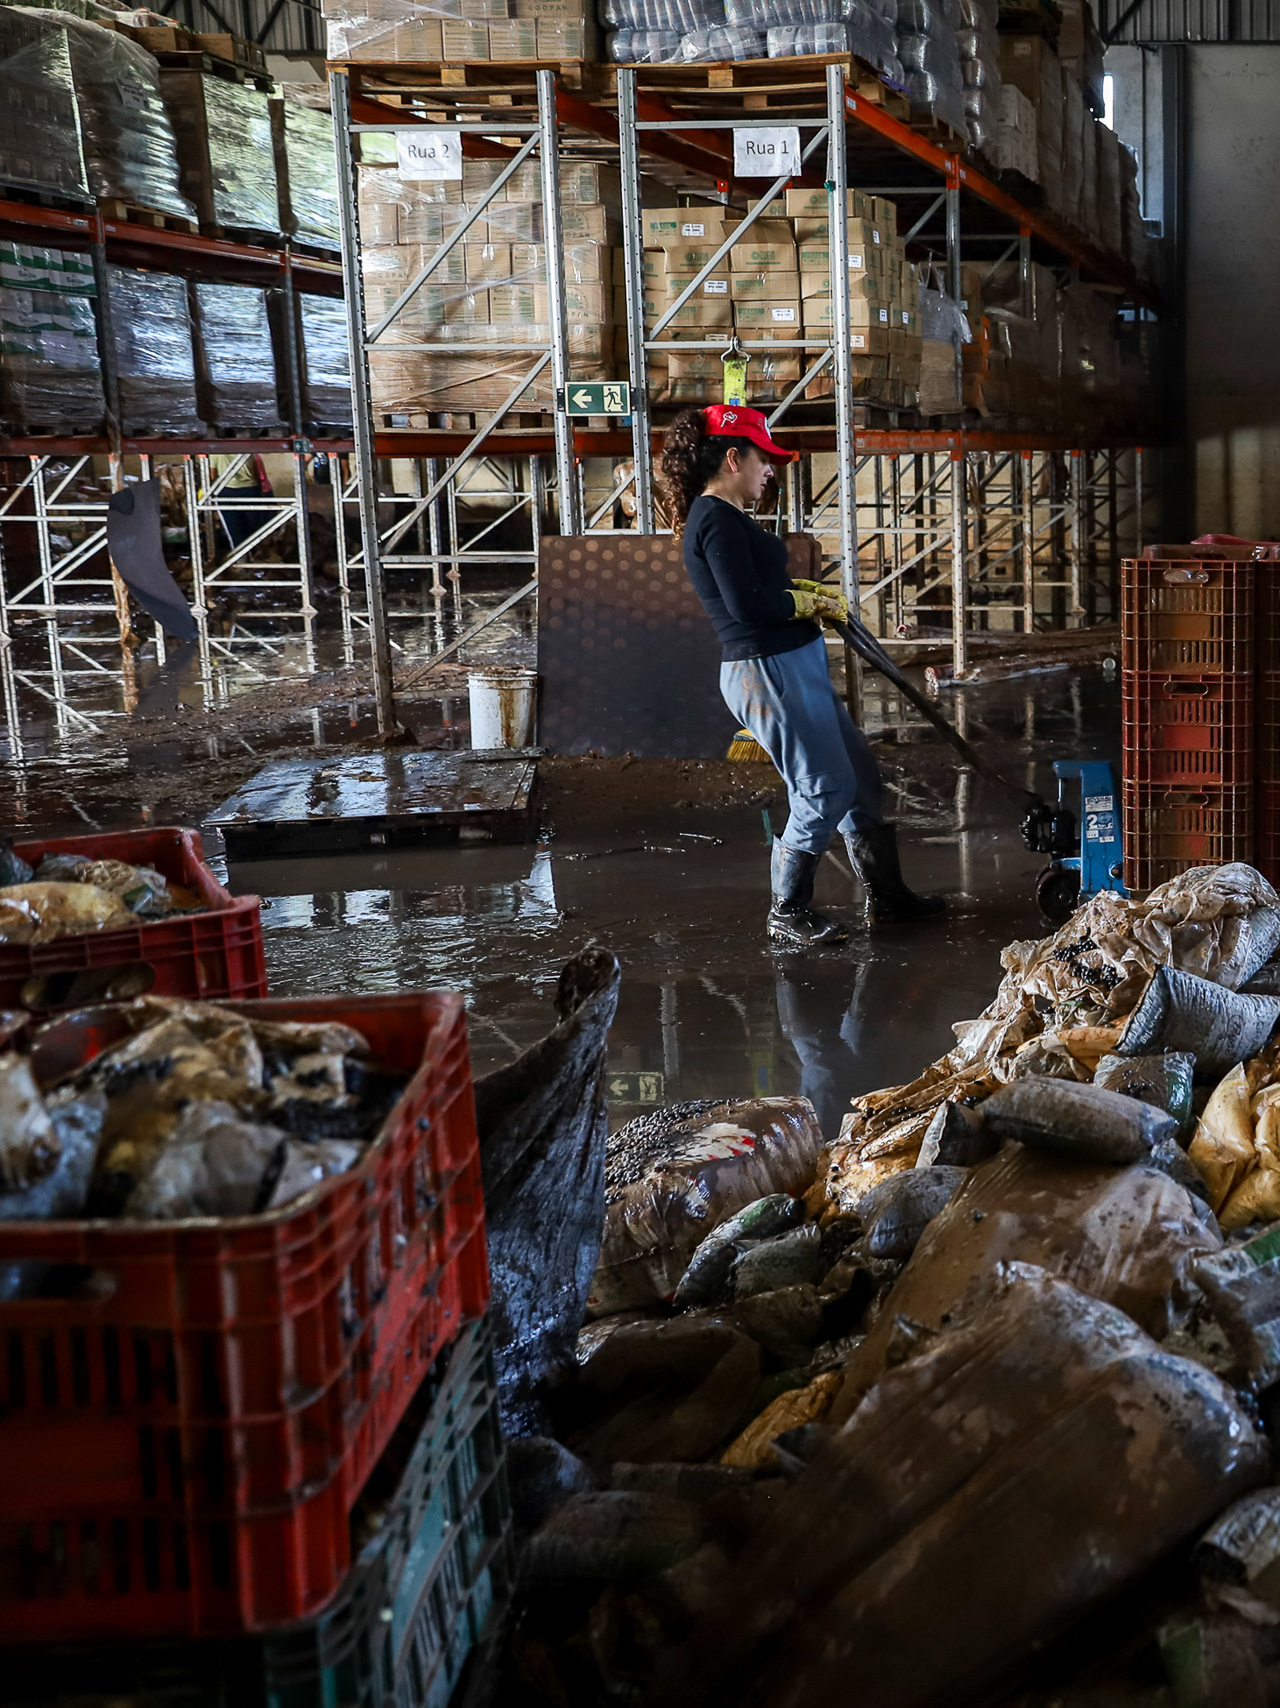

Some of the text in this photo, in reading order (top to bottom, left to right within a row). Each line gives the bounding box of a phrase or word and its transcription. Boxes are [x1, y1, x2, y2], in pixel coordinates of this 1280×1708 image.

[408, 143, 450, 159] Rua 2
[746, 140, 790, 155] Rua 1
[1086, 813, 1099, 830] 2
